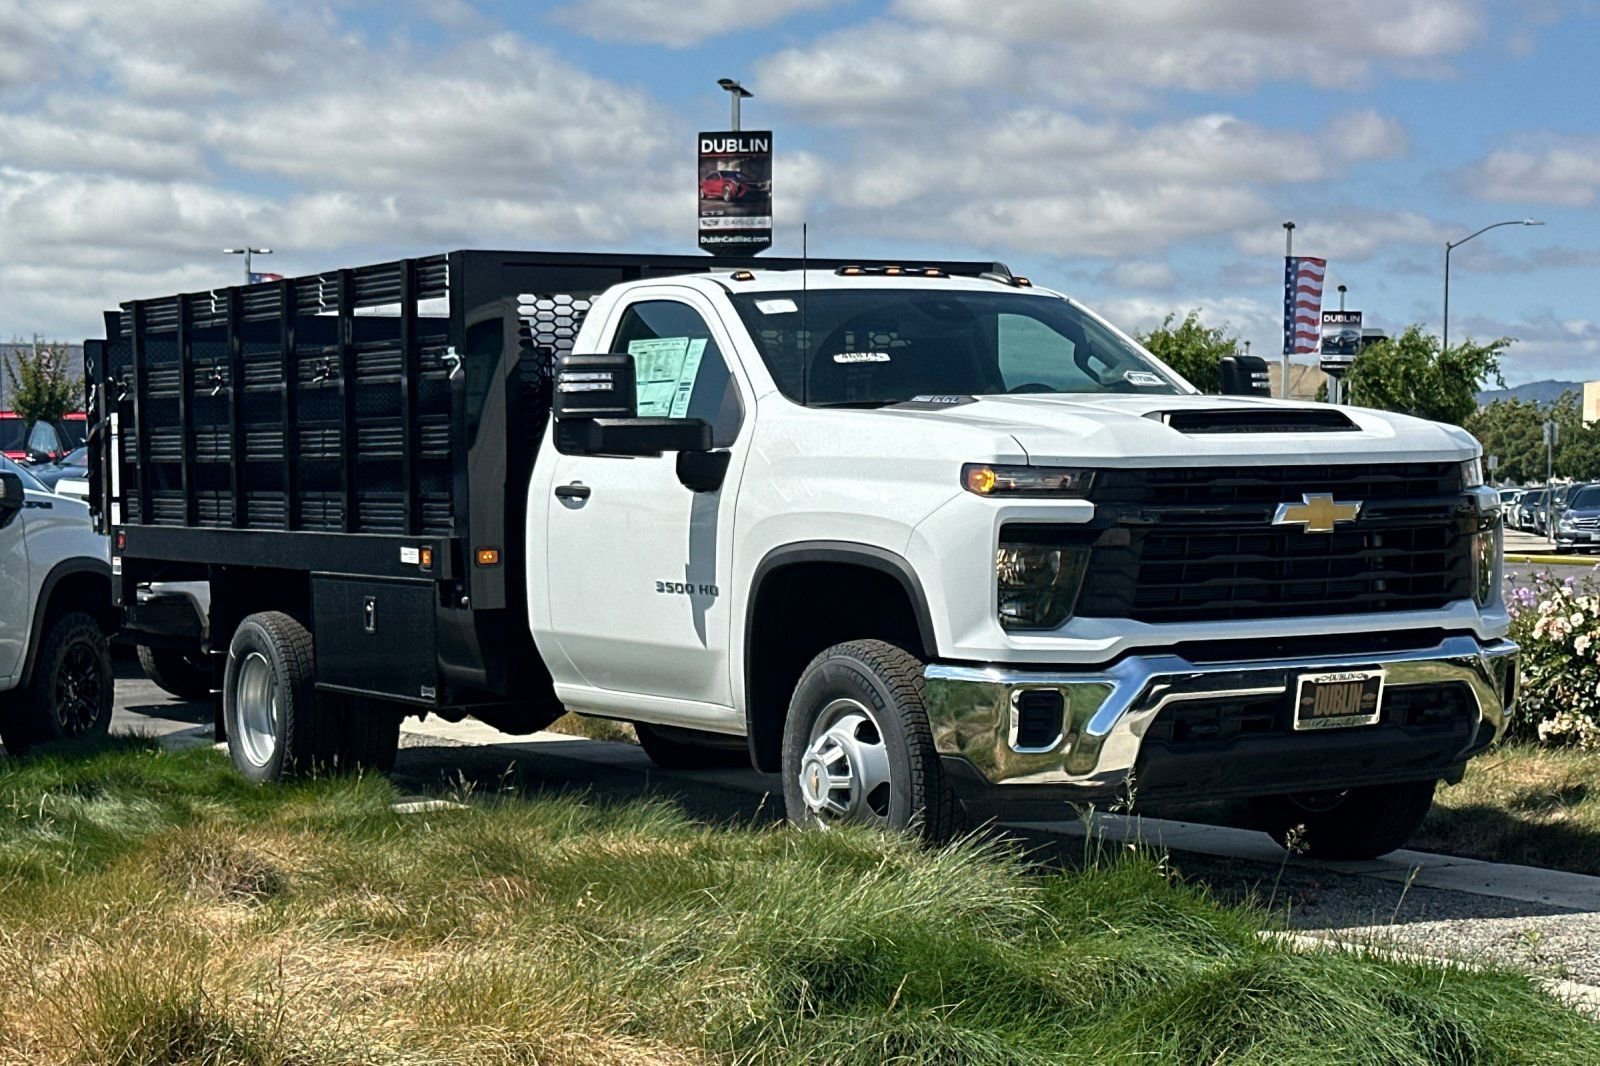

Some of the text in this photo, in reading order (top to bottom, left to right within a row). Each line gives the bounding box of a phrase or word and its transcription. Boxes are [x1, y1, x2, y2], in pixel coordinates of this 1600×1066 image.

[701, 138, 768, 153] DUBLIN
[700, 235, 769, 243] DublinCadillac.com
[1323, 314, 1361, 323] DUBLIN
[656, 581, 719, 597] 3500 HD
[1329, 673, 1355, 681] DUBLIN
[1313, 683, 1363, 716] DUBLIN
